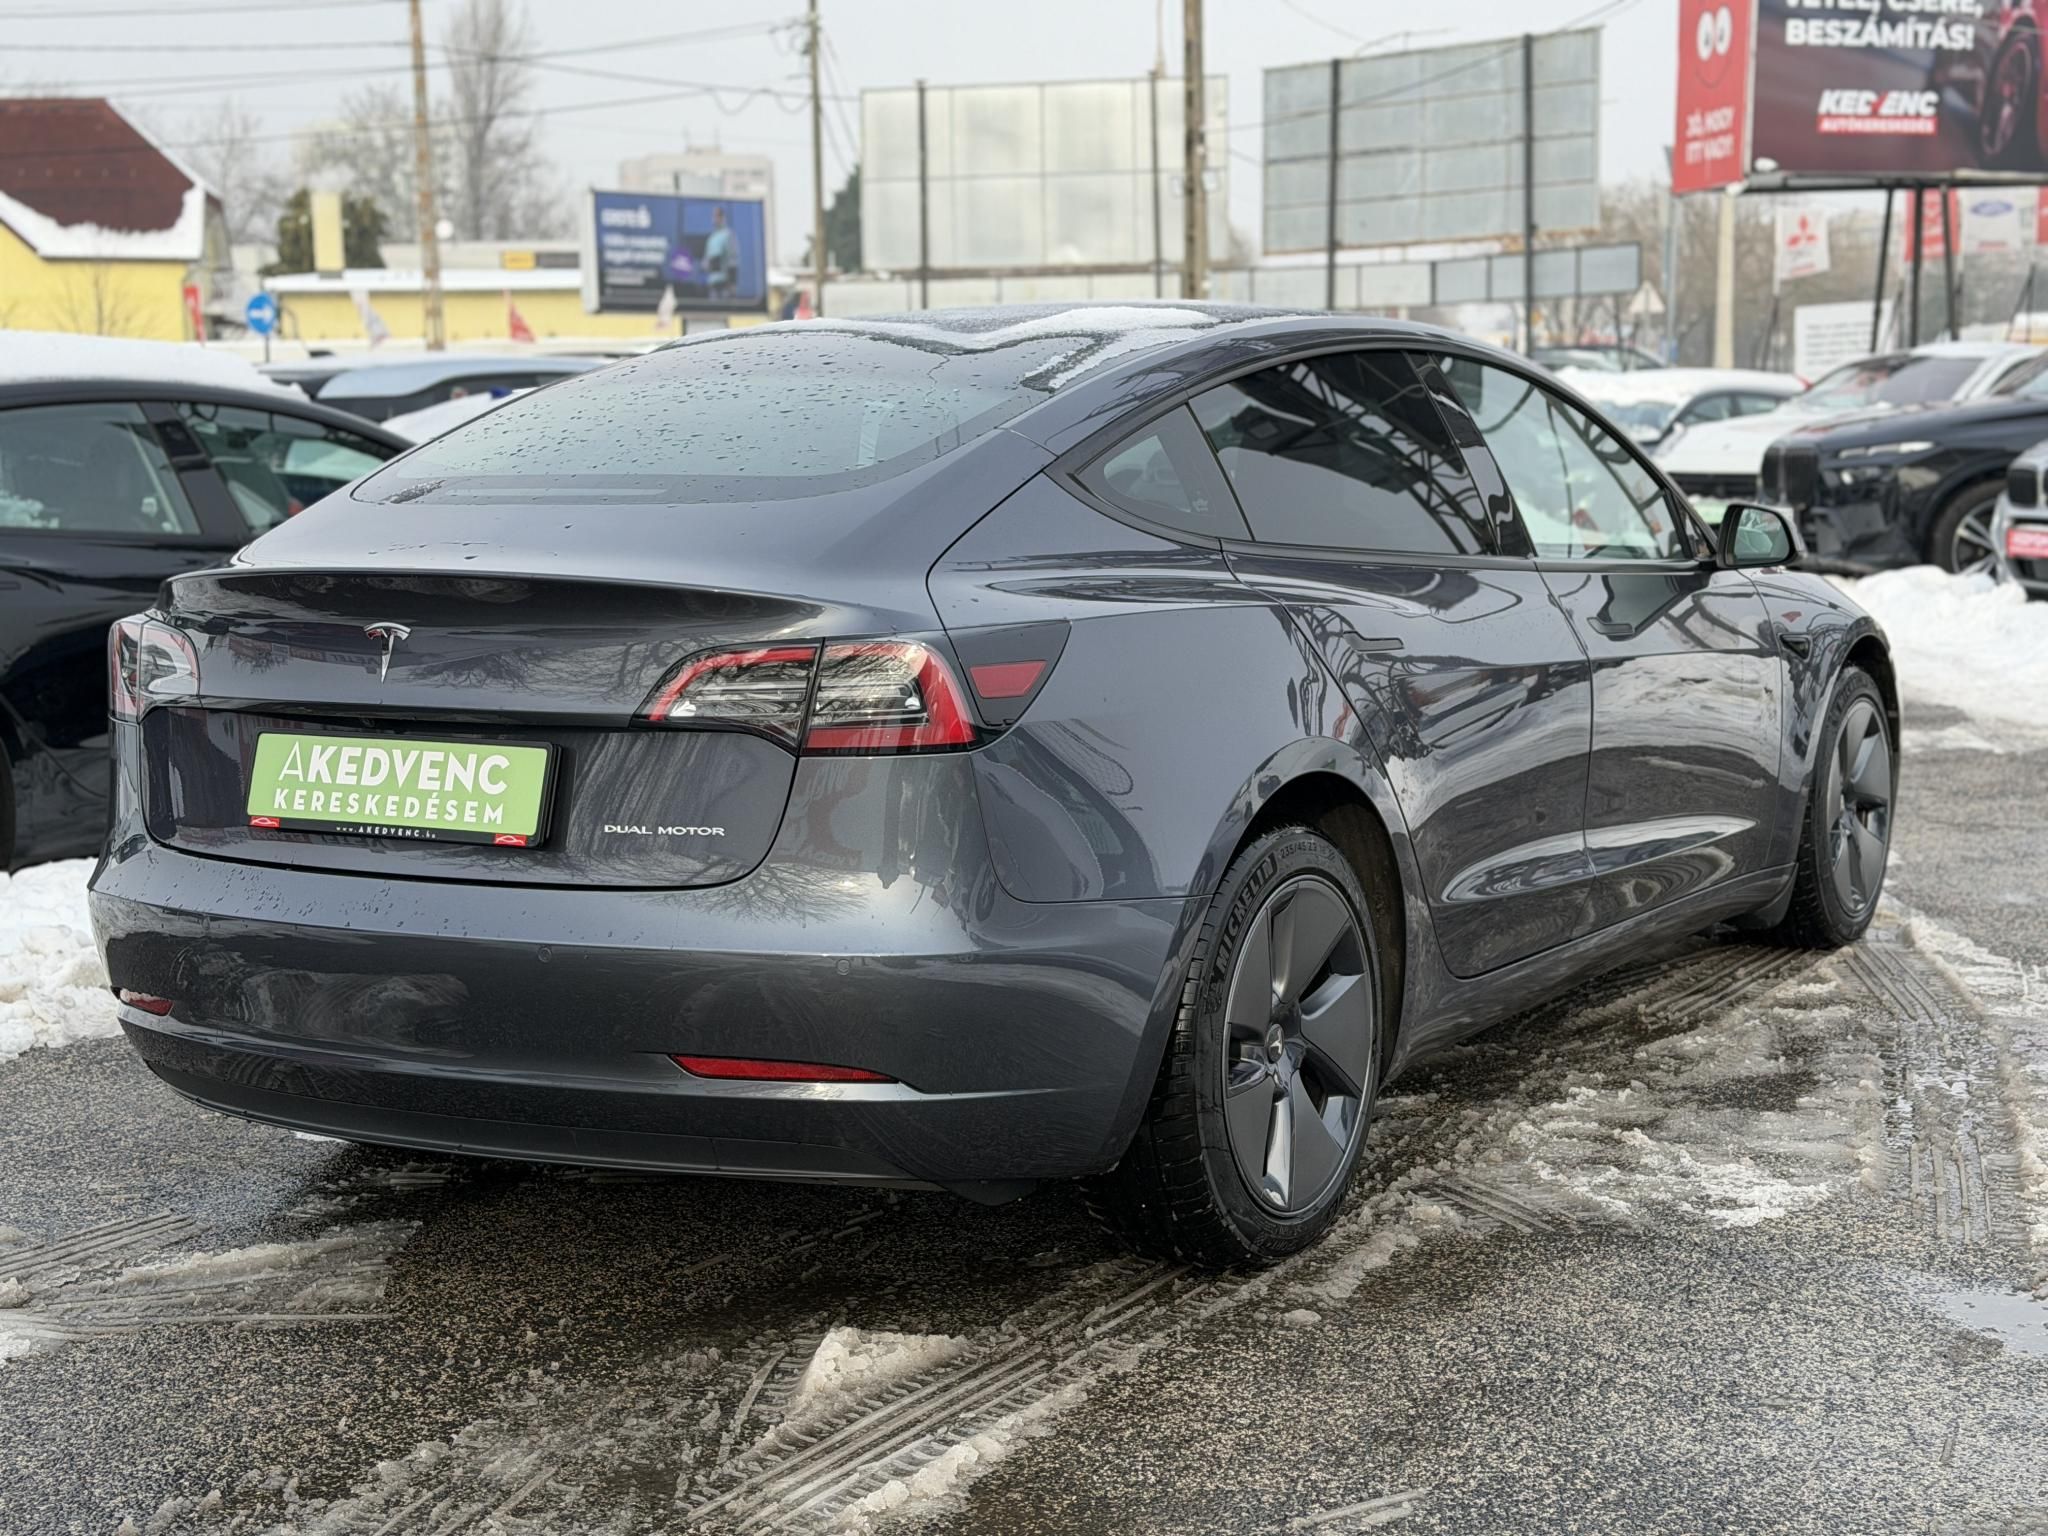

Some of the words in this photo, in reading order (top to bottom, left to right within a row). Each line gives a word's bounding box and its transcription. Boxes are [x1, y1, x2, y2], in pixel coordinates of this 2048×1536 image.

[1785, 15, 1975, 50] BESZÁMÍTÁS!
[278, 741, 510, 795] AKEDVENC
[273, 788, 504, 825] KERESKEDÉSEM
[604, 825, 653, 835] DUAL
[658, 826, 725, 836] MOTOR
[1214, 852, 1277, 977] MICHELIN
